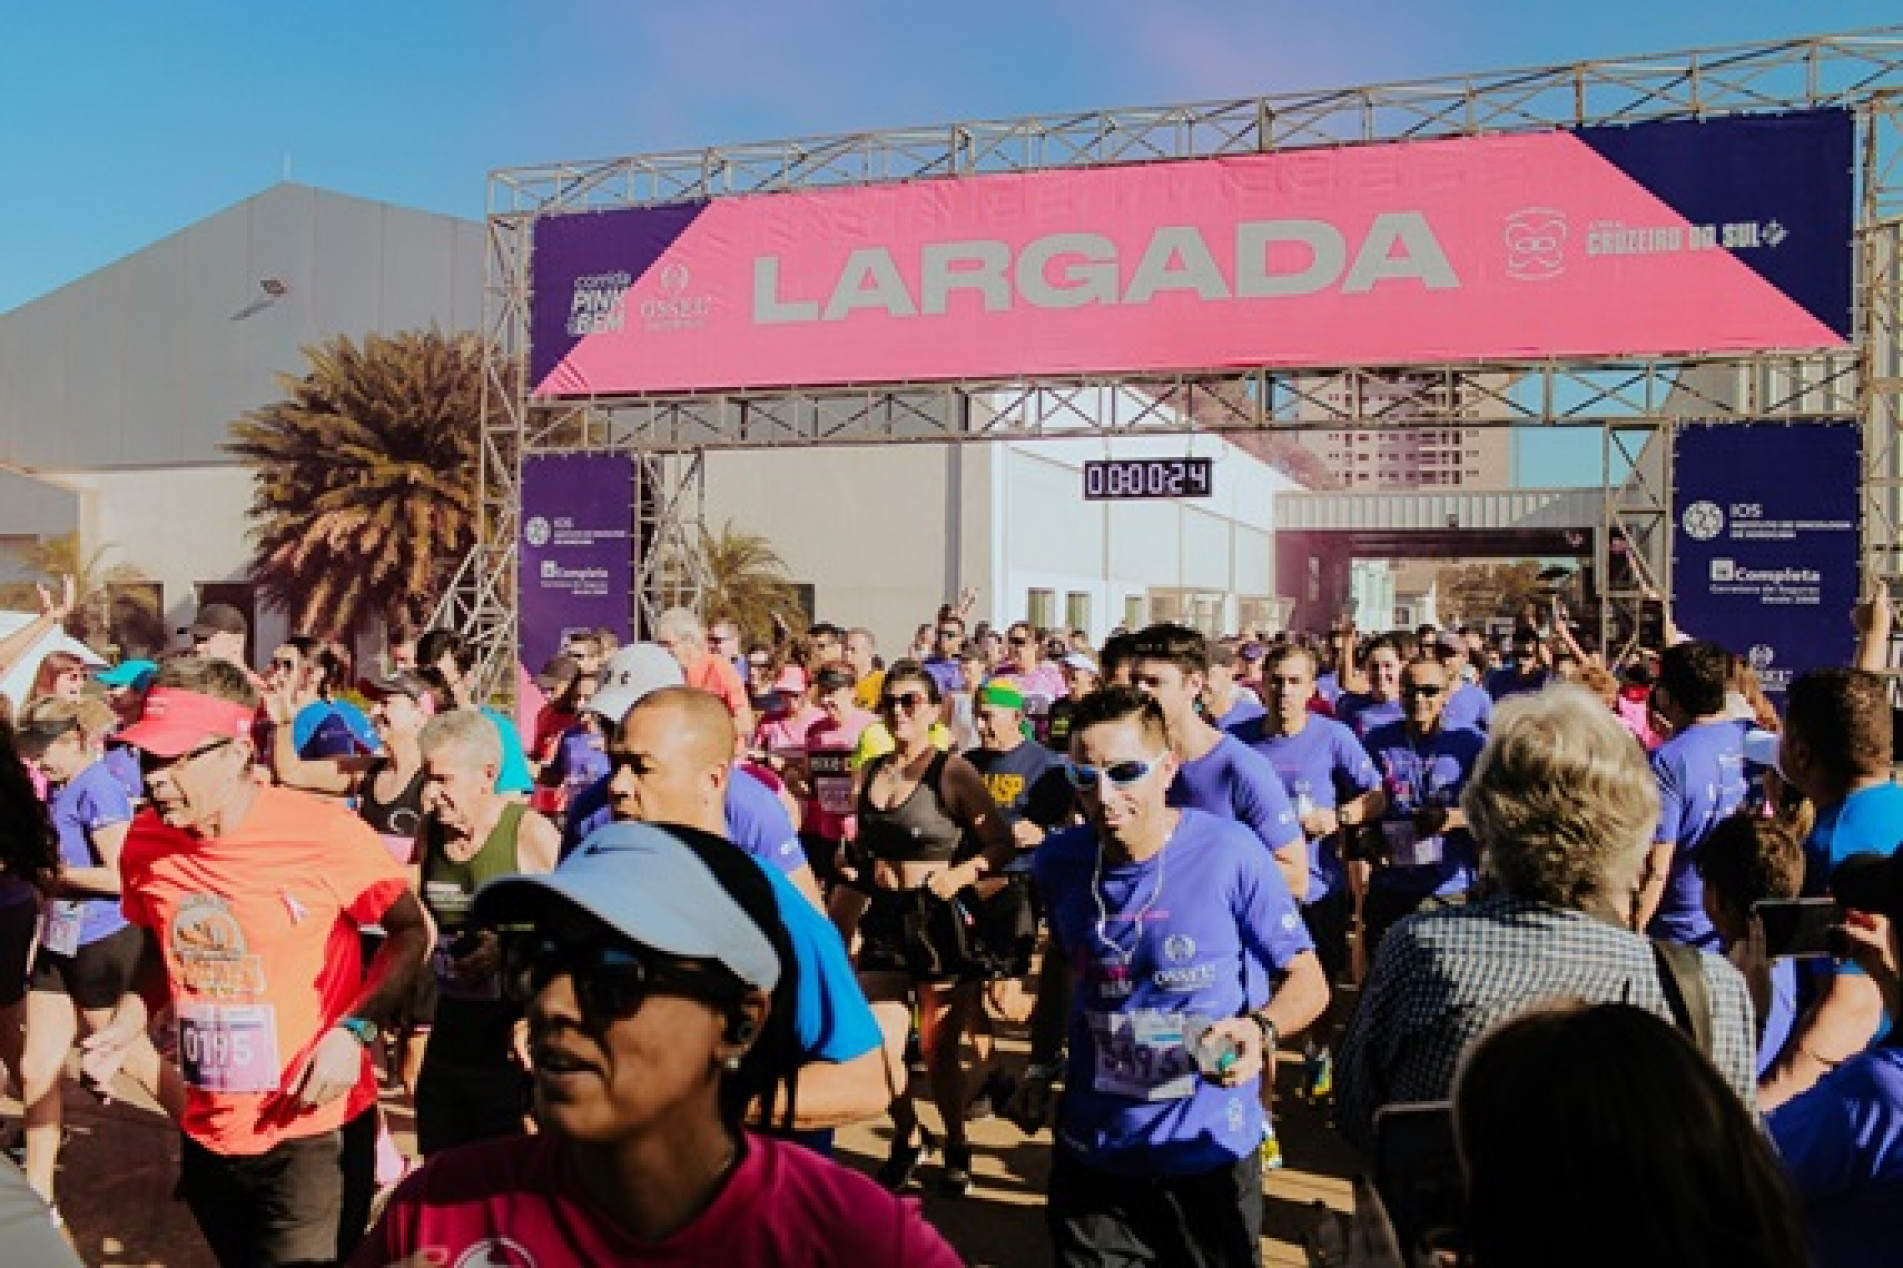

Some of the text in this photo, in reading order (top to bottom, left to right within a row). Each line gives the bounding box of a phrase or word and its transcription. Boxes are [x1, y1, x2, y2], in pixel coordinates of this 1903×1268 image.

[1586, 222, 1761, 255] CRUZEIRO DO SUL
[752, 211, 1462, 325] LARGADA
[1087, 462, 1206, 494] 00:00:24
[1735, 566, 1821, 585] Completa
